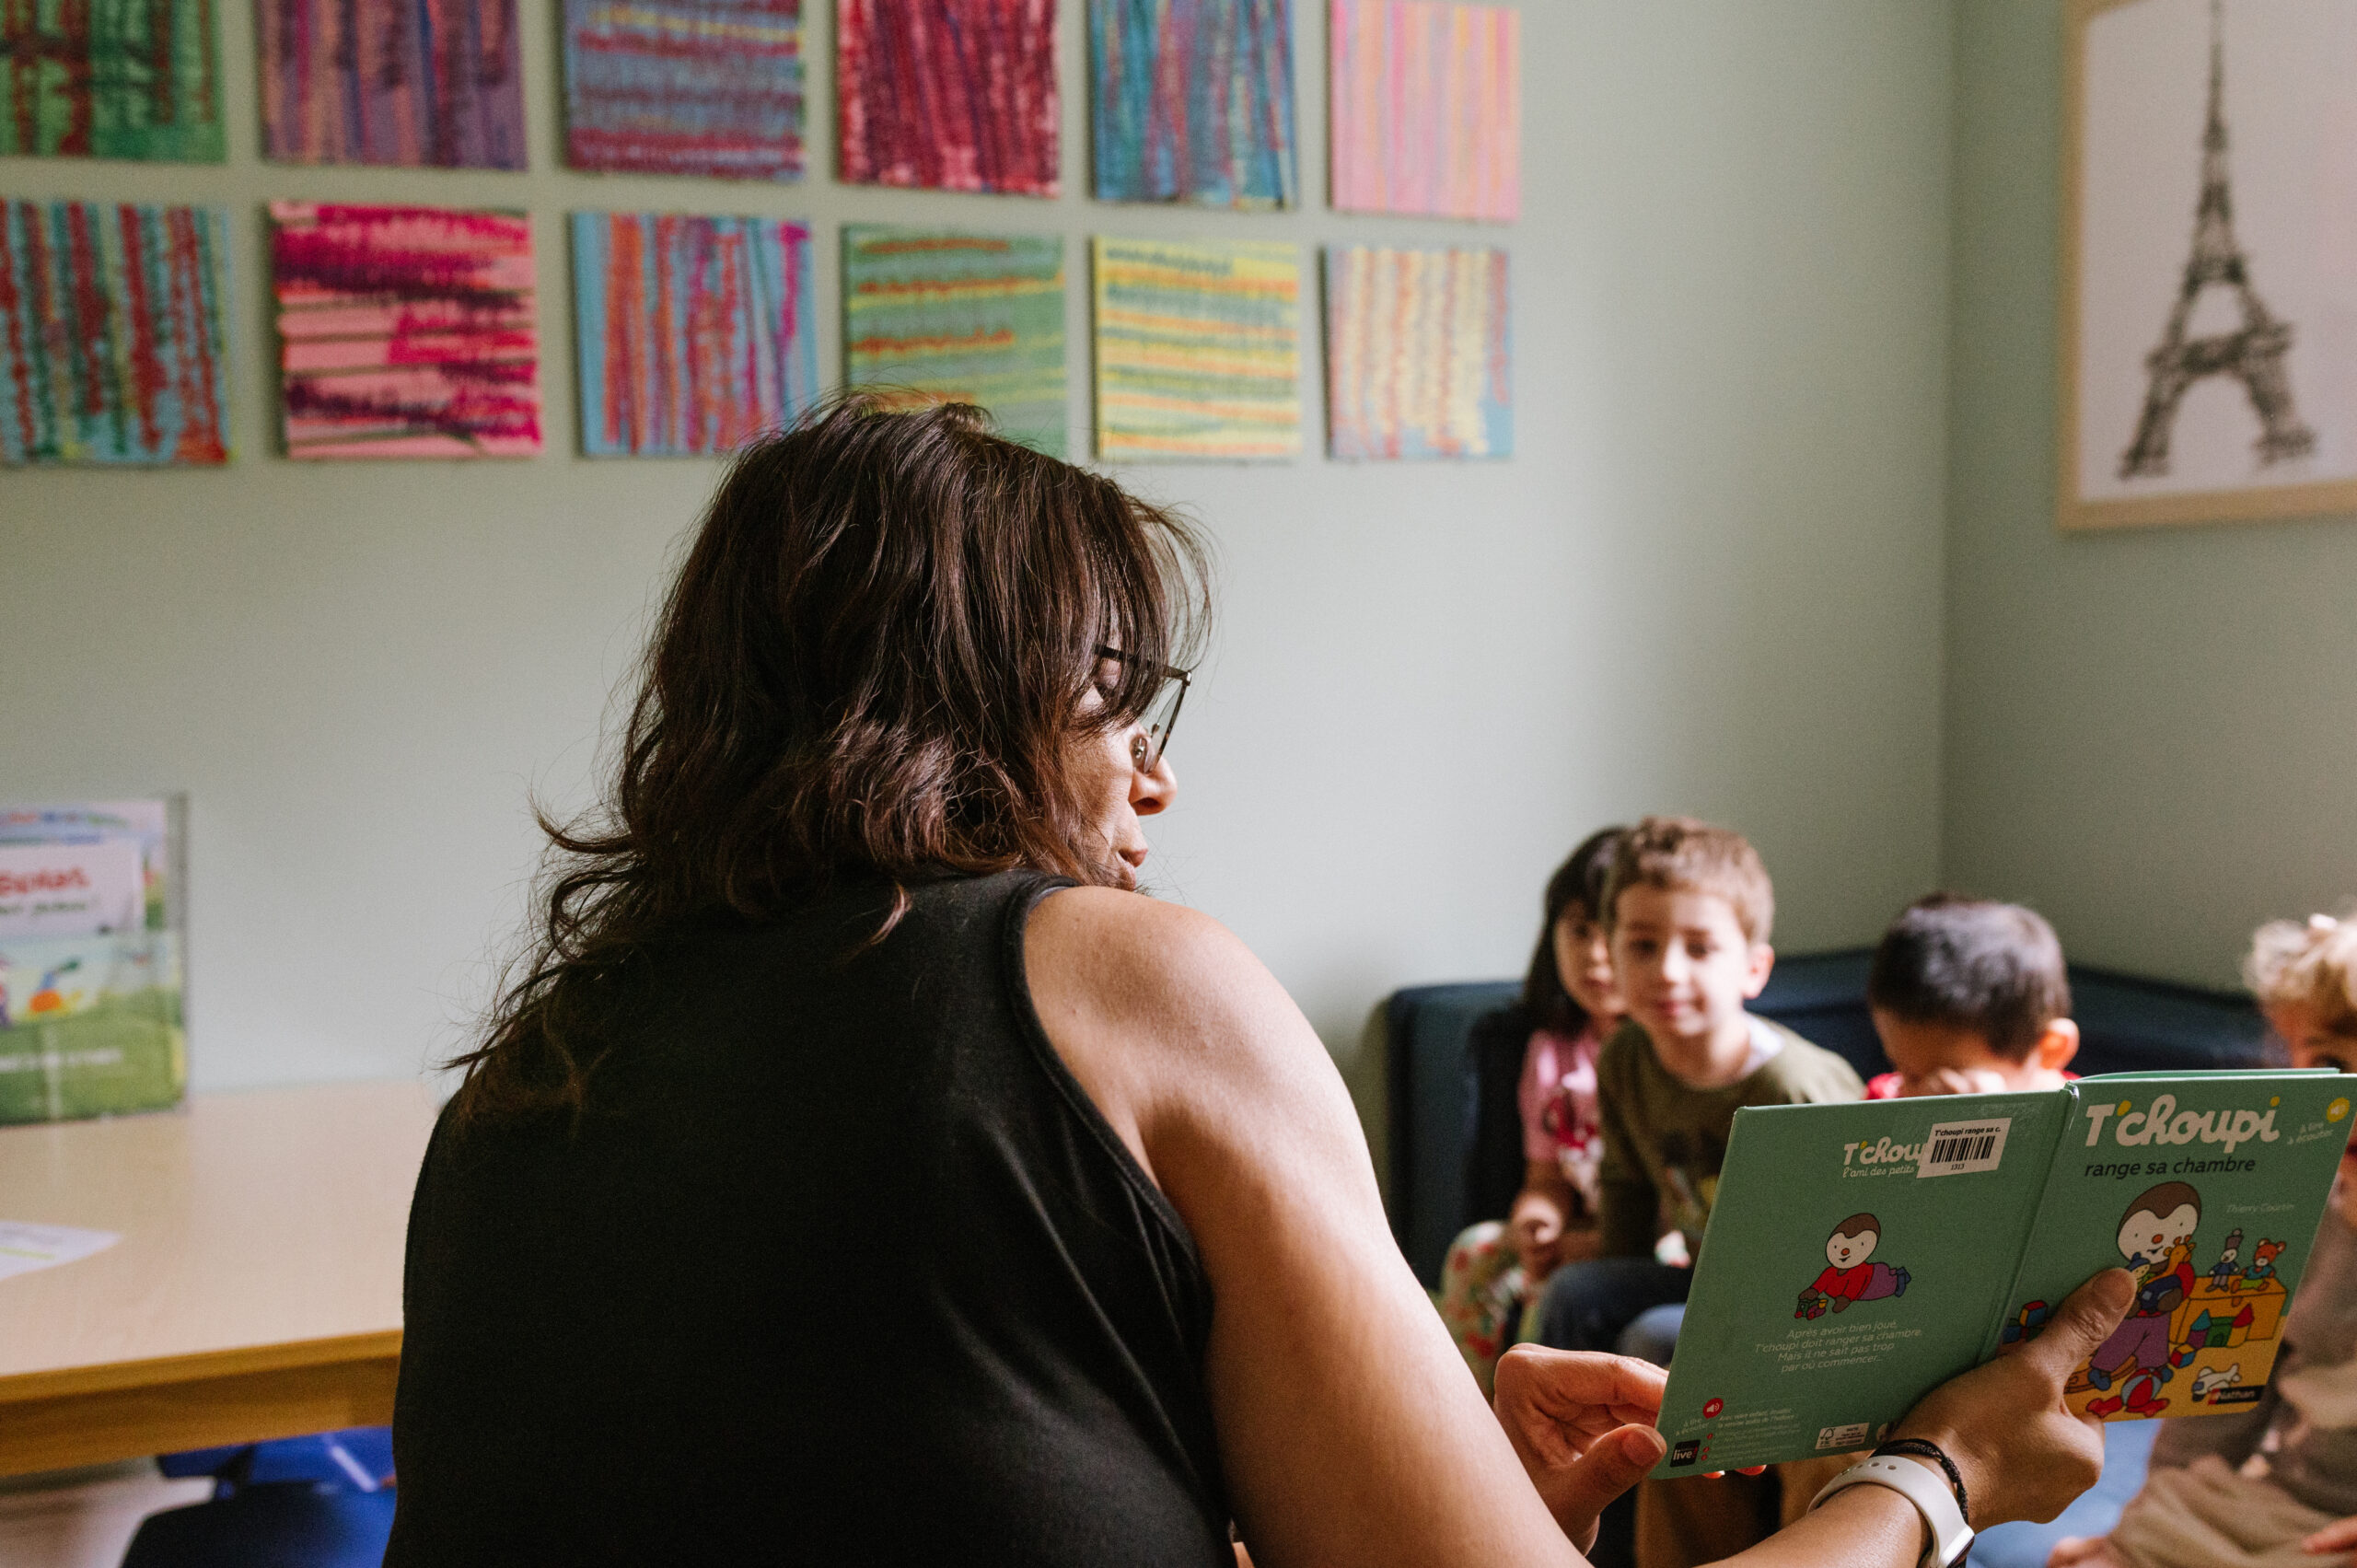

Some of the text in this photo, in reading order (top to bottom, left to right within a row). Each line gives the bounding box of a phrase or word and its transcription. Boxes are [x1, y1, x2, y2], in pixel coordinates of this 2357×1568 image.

[1935, 1128, 1964, 1137] T'choupi
[1965, 1127, 1985, 1135] range
[2085, 1094, 2281, 1154] T'choupi
[1843, 1136, 1929, 1167] T'chou
[1842, 1164, 1915, 1179] l'ami des petits
[2084, 1156, 2256, 1180] range sa chambre
[1787, 1328, 1817, 1340] Après
[1820, 1325, 1847, 1336] avoir
[1849, 1323, 1872, 1332] bien
[1755, 1341, 1799, 1353] T'choupi
[1802, 1339, 1823, 1349] doit
[1825, 1334, 1860, 1347] ranger
[1862, 1333, 1875, 1342] sa
[1777, 1342, 1895, 1363] Mais il ne sait pas trop
[1781, 1364, 1801, 1374] par
[1801, 1359, 1816, 1370] où
